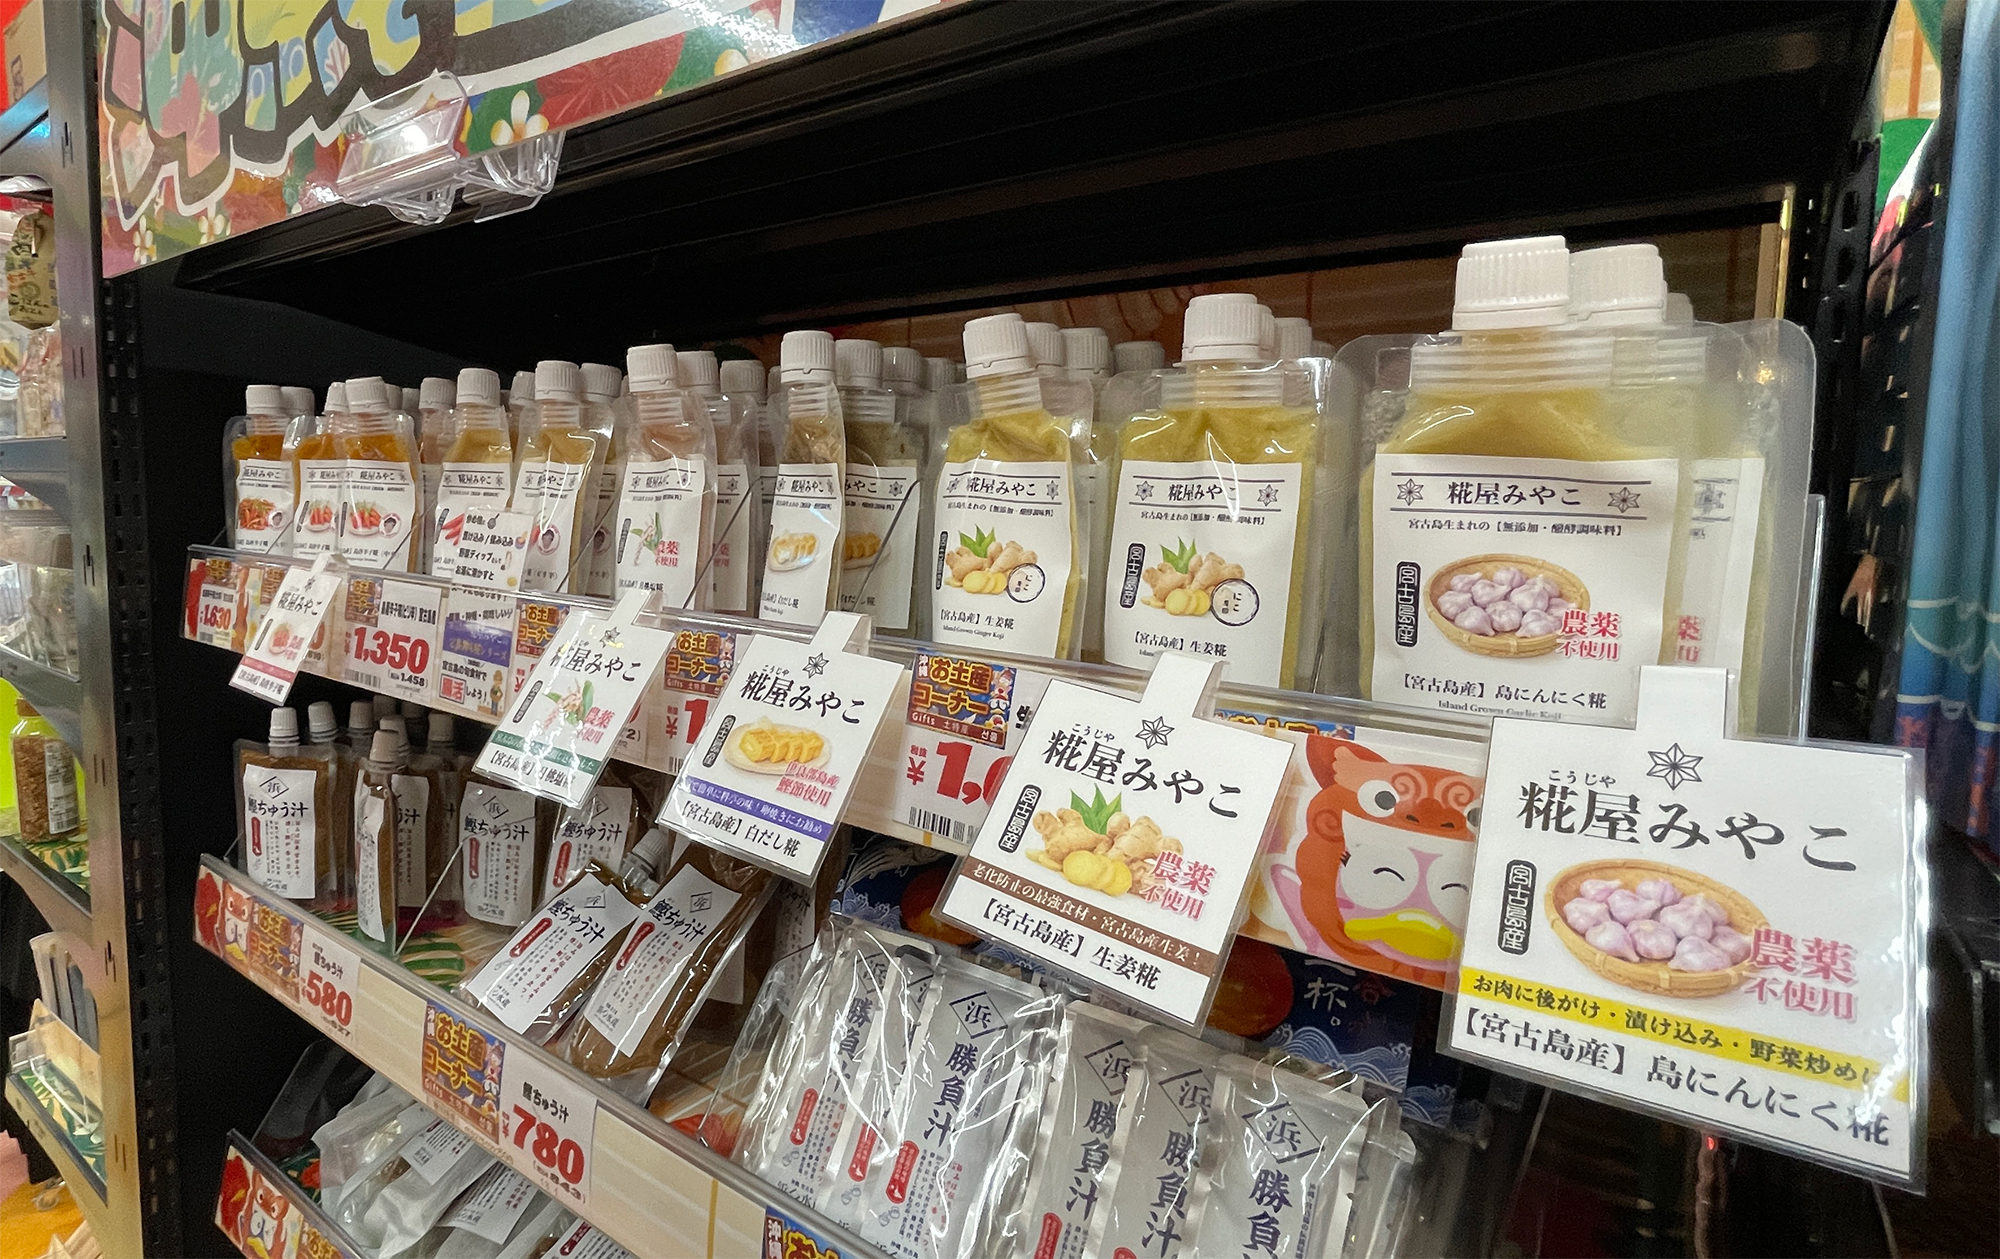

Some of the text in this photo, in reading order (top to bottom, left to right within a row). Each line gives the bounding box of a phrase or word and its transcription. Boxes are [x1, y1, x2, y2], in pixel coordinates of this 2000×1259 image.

[966, 477, 1036, 496] 糀屋みやこ
[1447, 481, 1583, 507] 糀屋みやこ
[677, 630, 721, 657] お土産
[1560, 611, 1622, 638] 農薬
[354, 626, 430, 675] 1,350
[665, 654, 719, 678] コーナー
[1560, 641, 1620, 661] 不使用
[930, 657, 993, 694] お土産
[740, 671, 866, 724] 糀屋みやこ
[911, 681, 991, 715] コーナー
[912, 711, 935, 726] Gifts
[1438, 700, 1468, 712] Island
[1470, 703, 1504, 716] Grown
[1071, 721, 1115, 742] こうじや
[1042, 729, 1243, 820] 糀屋みやこ
[1548, 768, 1617, 788] こうじや
[1516, 782, 1858, 873] 糀屋みやこ
[1152, 851, 1217, 896] 農薬
[547, 899, 605, 944] 鰹ちゅう汁
[649, 899, 708, 943] 鰹ちゅう汁
[1142, 885, 1205, 921] 不使用
[1749, 927, 1858, 984] 農薬
[306, 969, 353, 1027] 580
[963, 1000, 992, 1029] 浜
[1744, 977, 1858, 1022] 不使用
[435, 1012, 487, 1071] お土産
[422, 1042, 485, 1098] コーナー
[1101, 1052, 1131, 1086] 浜
[923, 1043, 979, 1147] 勝負汁
[513, 1103, 585, 1185] 780
[1265, 1111, 1303, 1152] 浜
[1065, 1100, 1117, 1222] 勝負汁
[1241, 1168, 1293, 1259] 勝負
